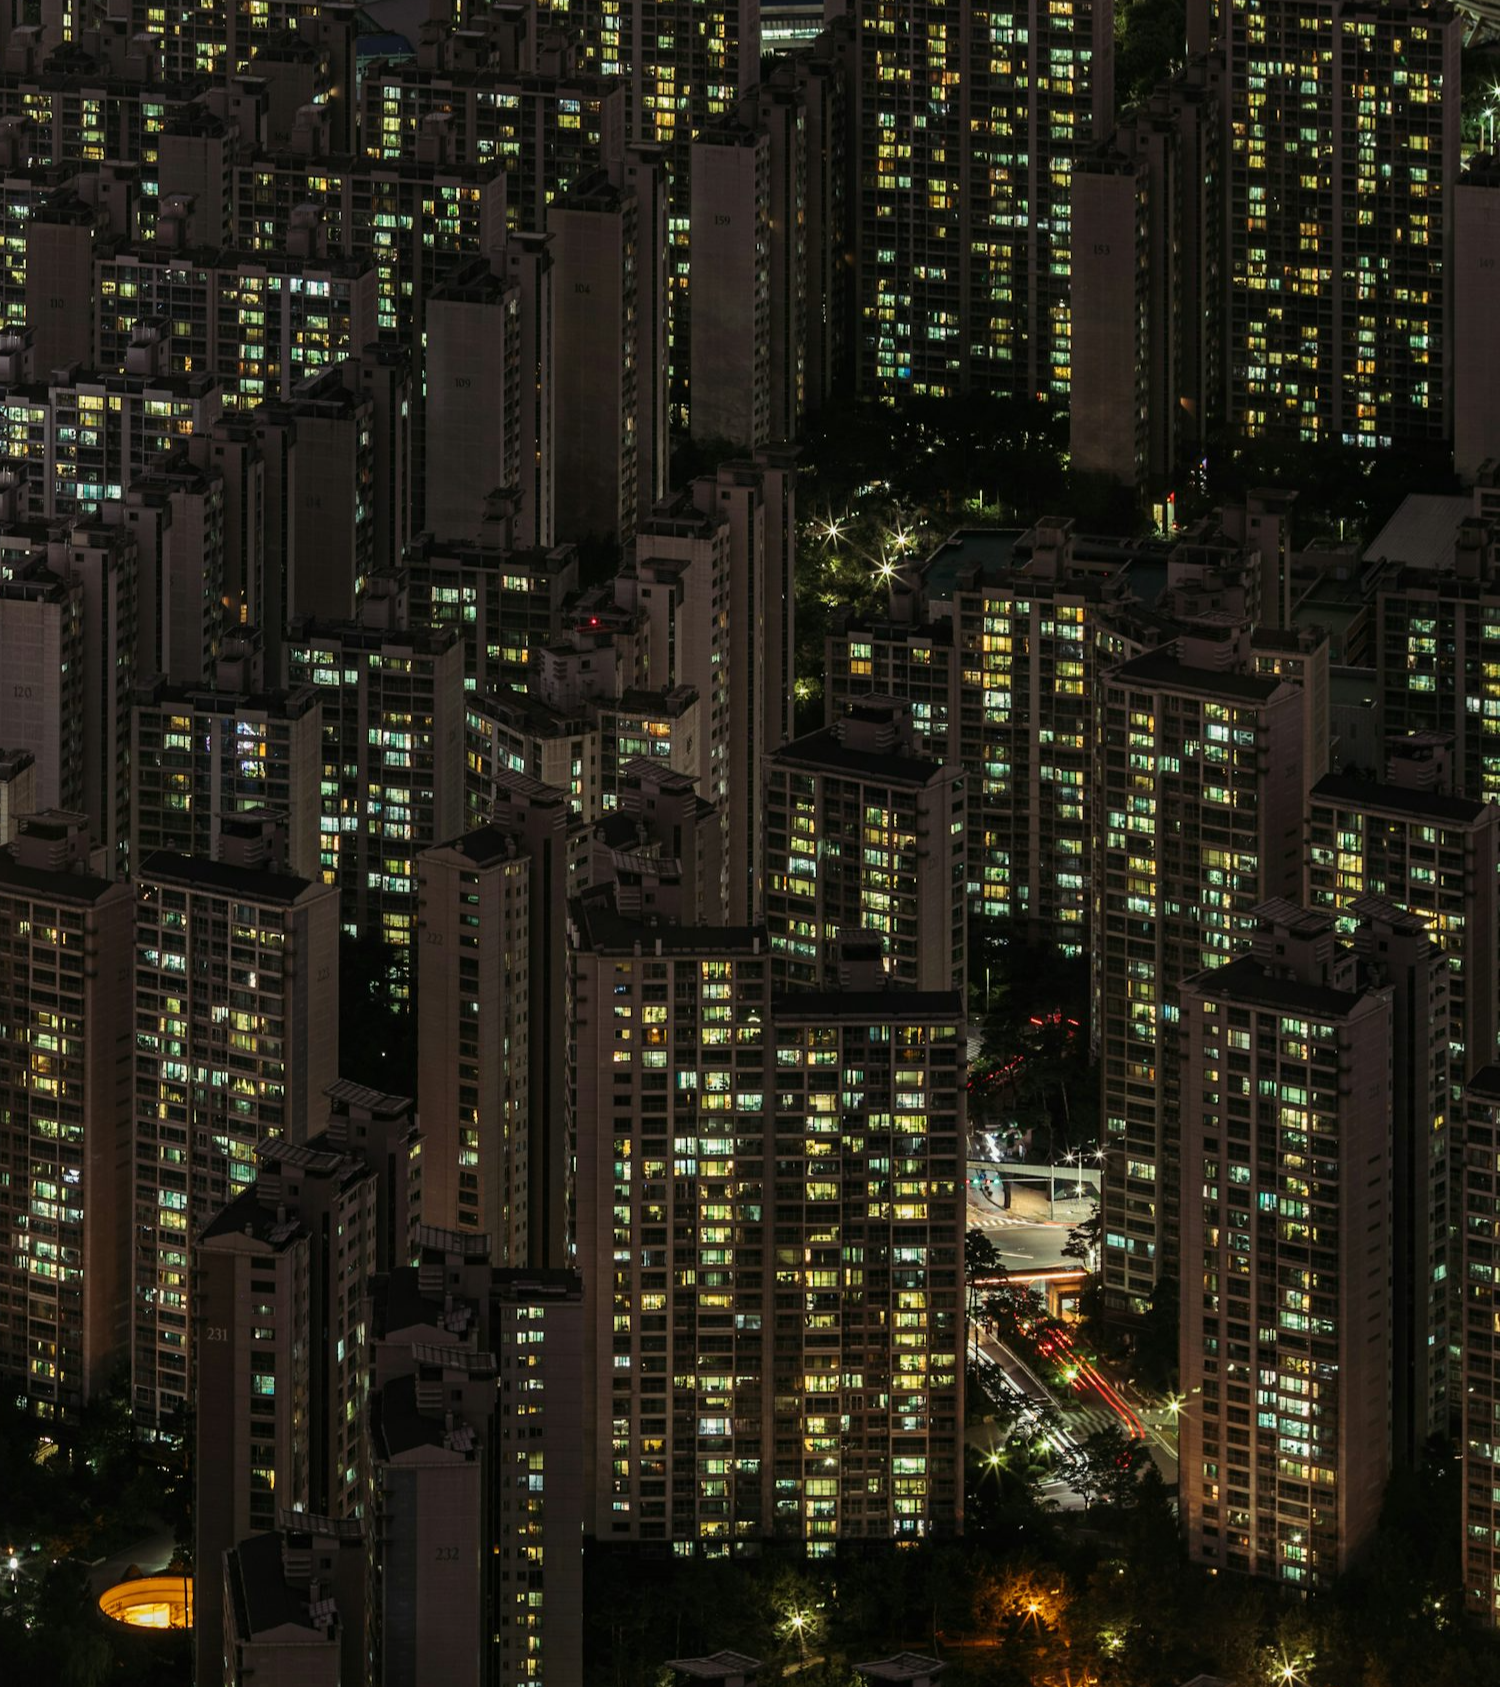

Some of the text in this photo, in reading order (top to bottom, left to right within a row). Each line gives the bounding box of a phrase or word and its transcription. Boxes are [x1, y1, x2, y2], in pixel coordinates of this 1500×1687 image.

[715, 215, 731, 225] 159
[1093, 245, 1110, 255] 153
[1479, 257, 1495, 268] 149
[574, 283, 590, 294] 104
[50, 298, 66, 309] 110
[455, 378, 471, 388] 109
[13, 686, 32, 698] 120
[426, 931, 443, 946] 222
[207, 1327, 228, 1341] 231
[435, 1547, 460, 1561] 232
